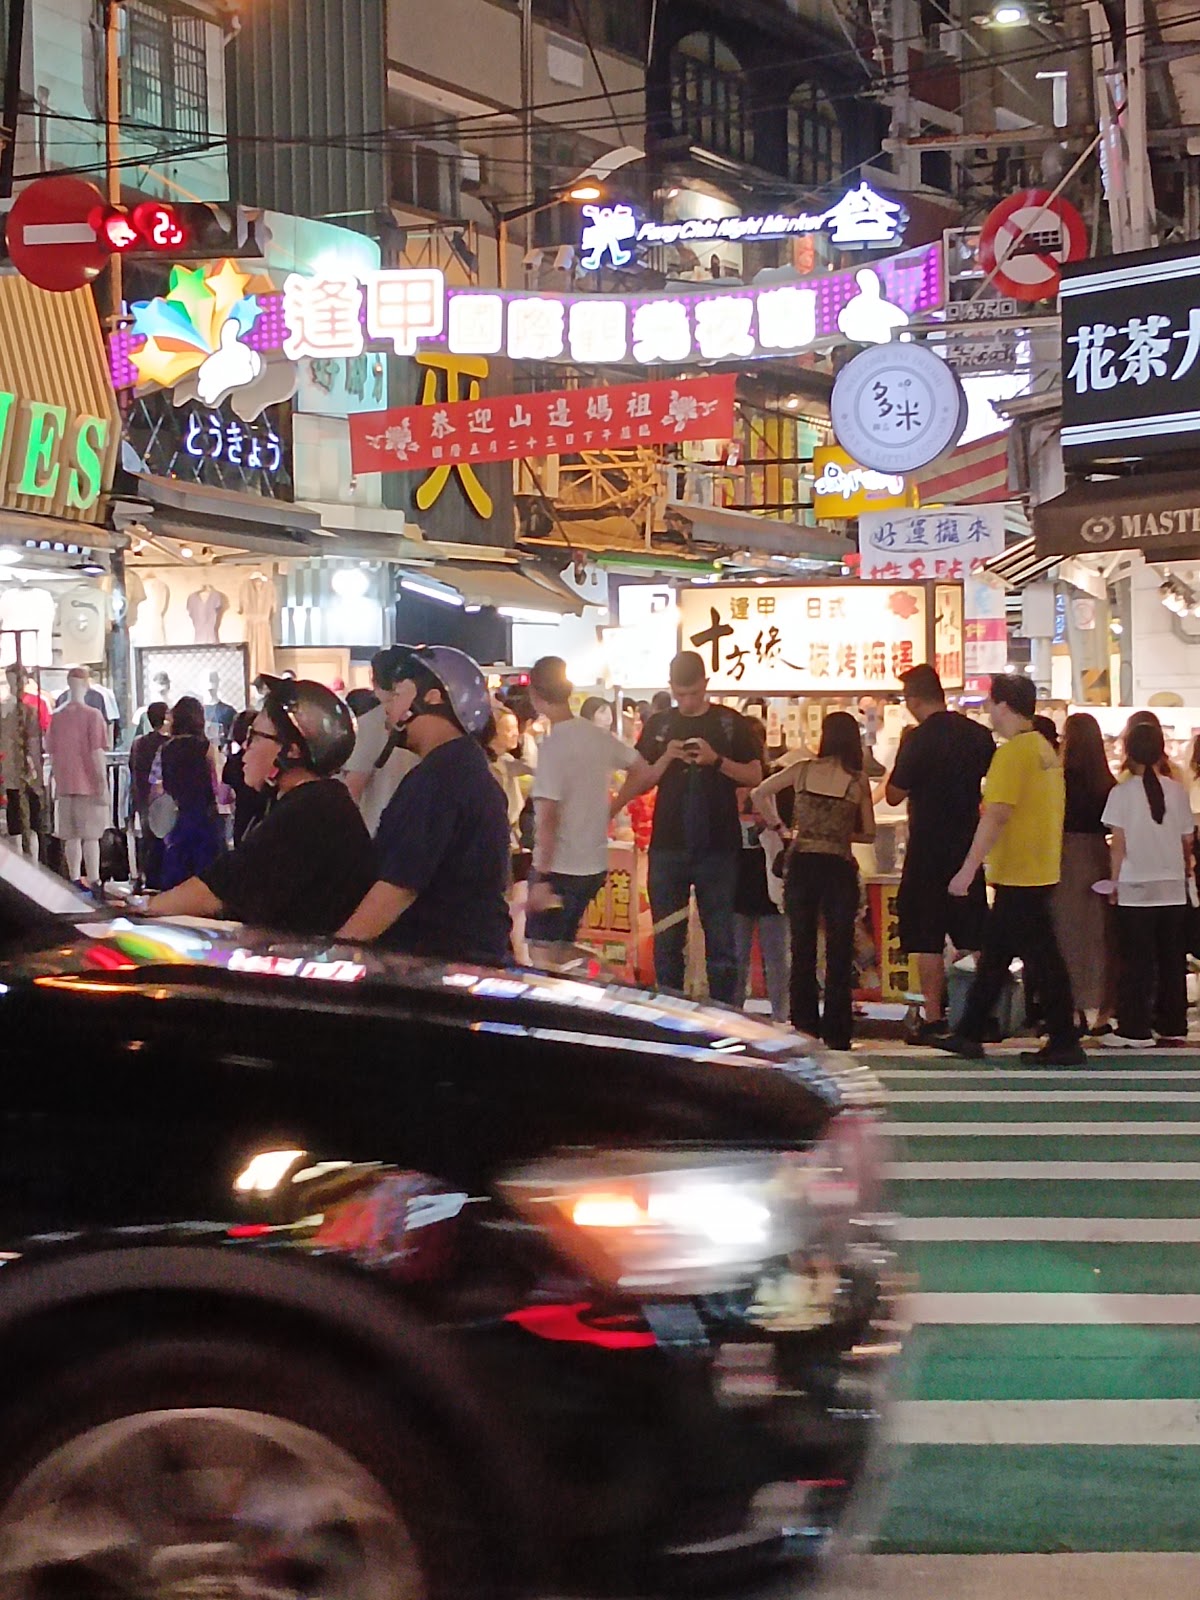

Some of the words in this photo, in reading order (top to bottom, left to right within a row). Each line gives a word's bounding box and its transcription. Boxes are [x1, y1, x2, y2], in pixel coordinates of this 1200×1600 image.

[186, 413, 280, 471] とうきょう
[730, 597, 776, 620] 逢甲
